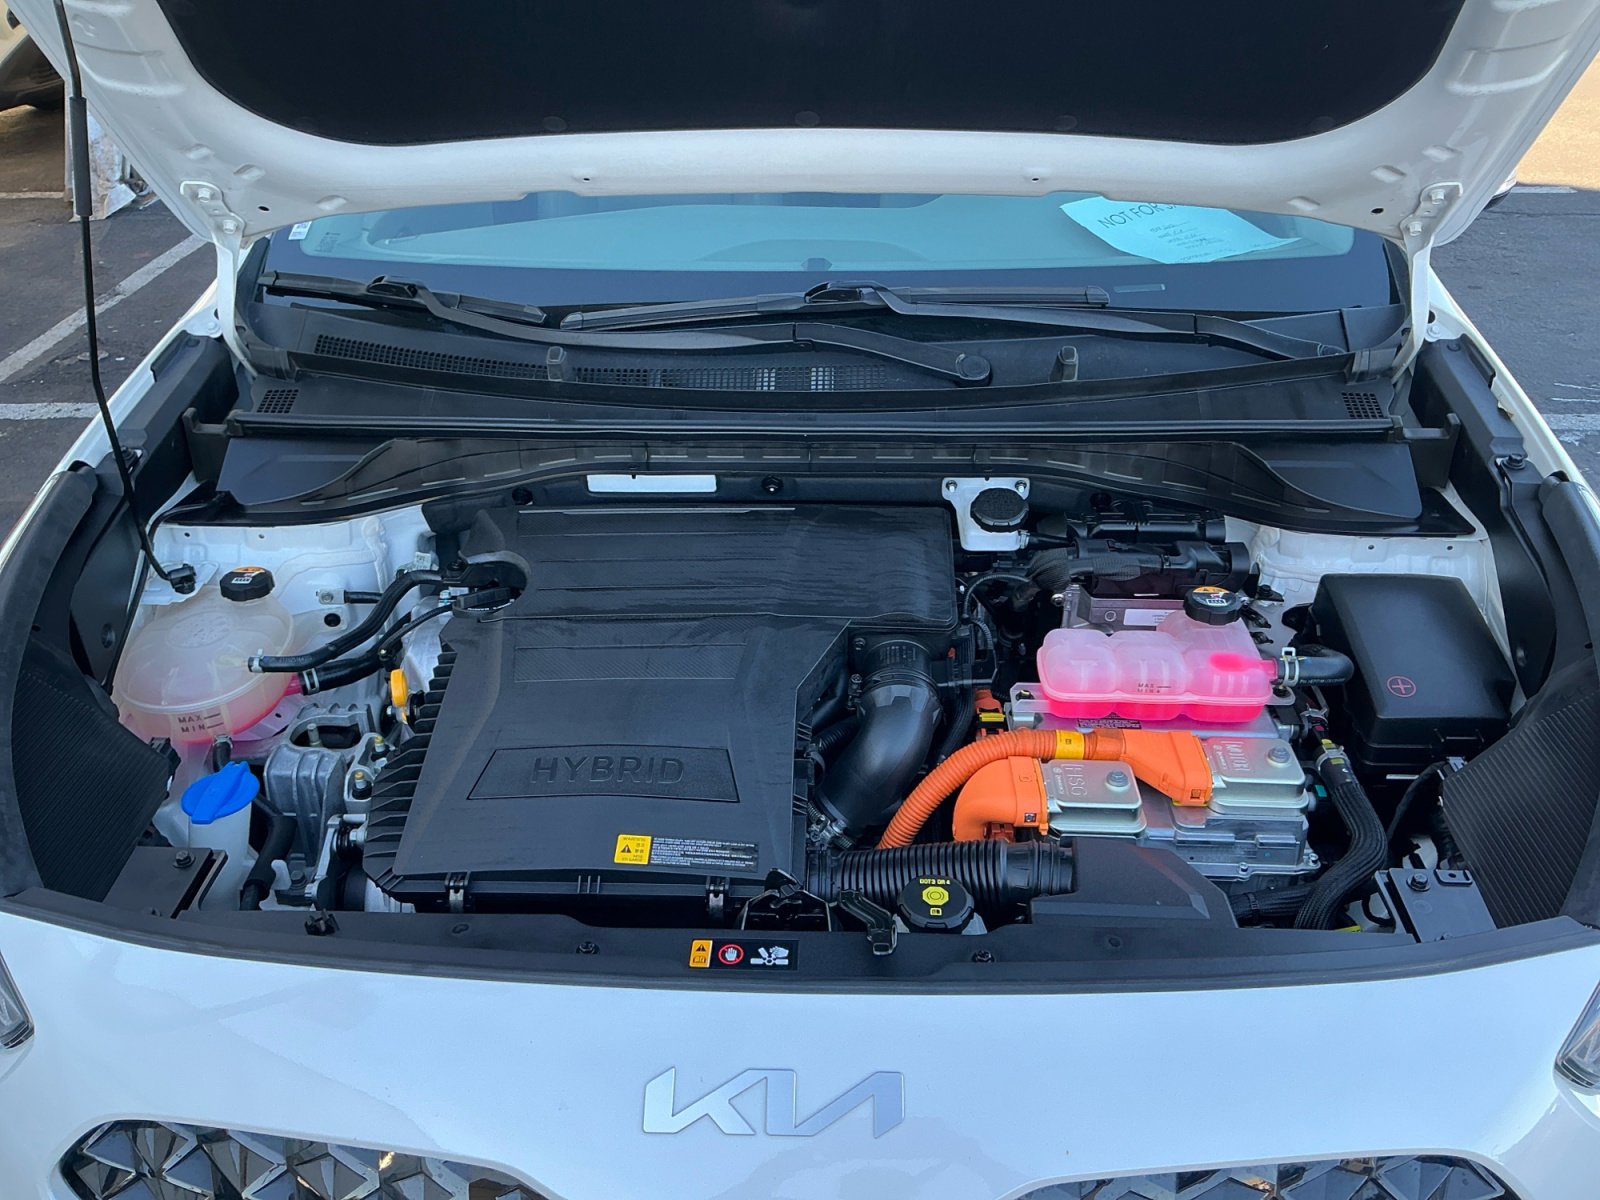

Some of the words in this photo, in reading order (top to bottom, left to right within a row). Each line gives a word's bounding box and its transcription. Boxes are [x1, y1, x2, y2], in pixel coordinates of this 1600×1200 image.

[1097, 211, 1133, 228] NOT
[1129, 202, 1164, 218] FOR
[178, 714, 202, 723] MAX
[180, 723, 205, 733] MIN
[529, 755, 685, 785] HYBRID
[642, 1065, 905, 1139] KIA
